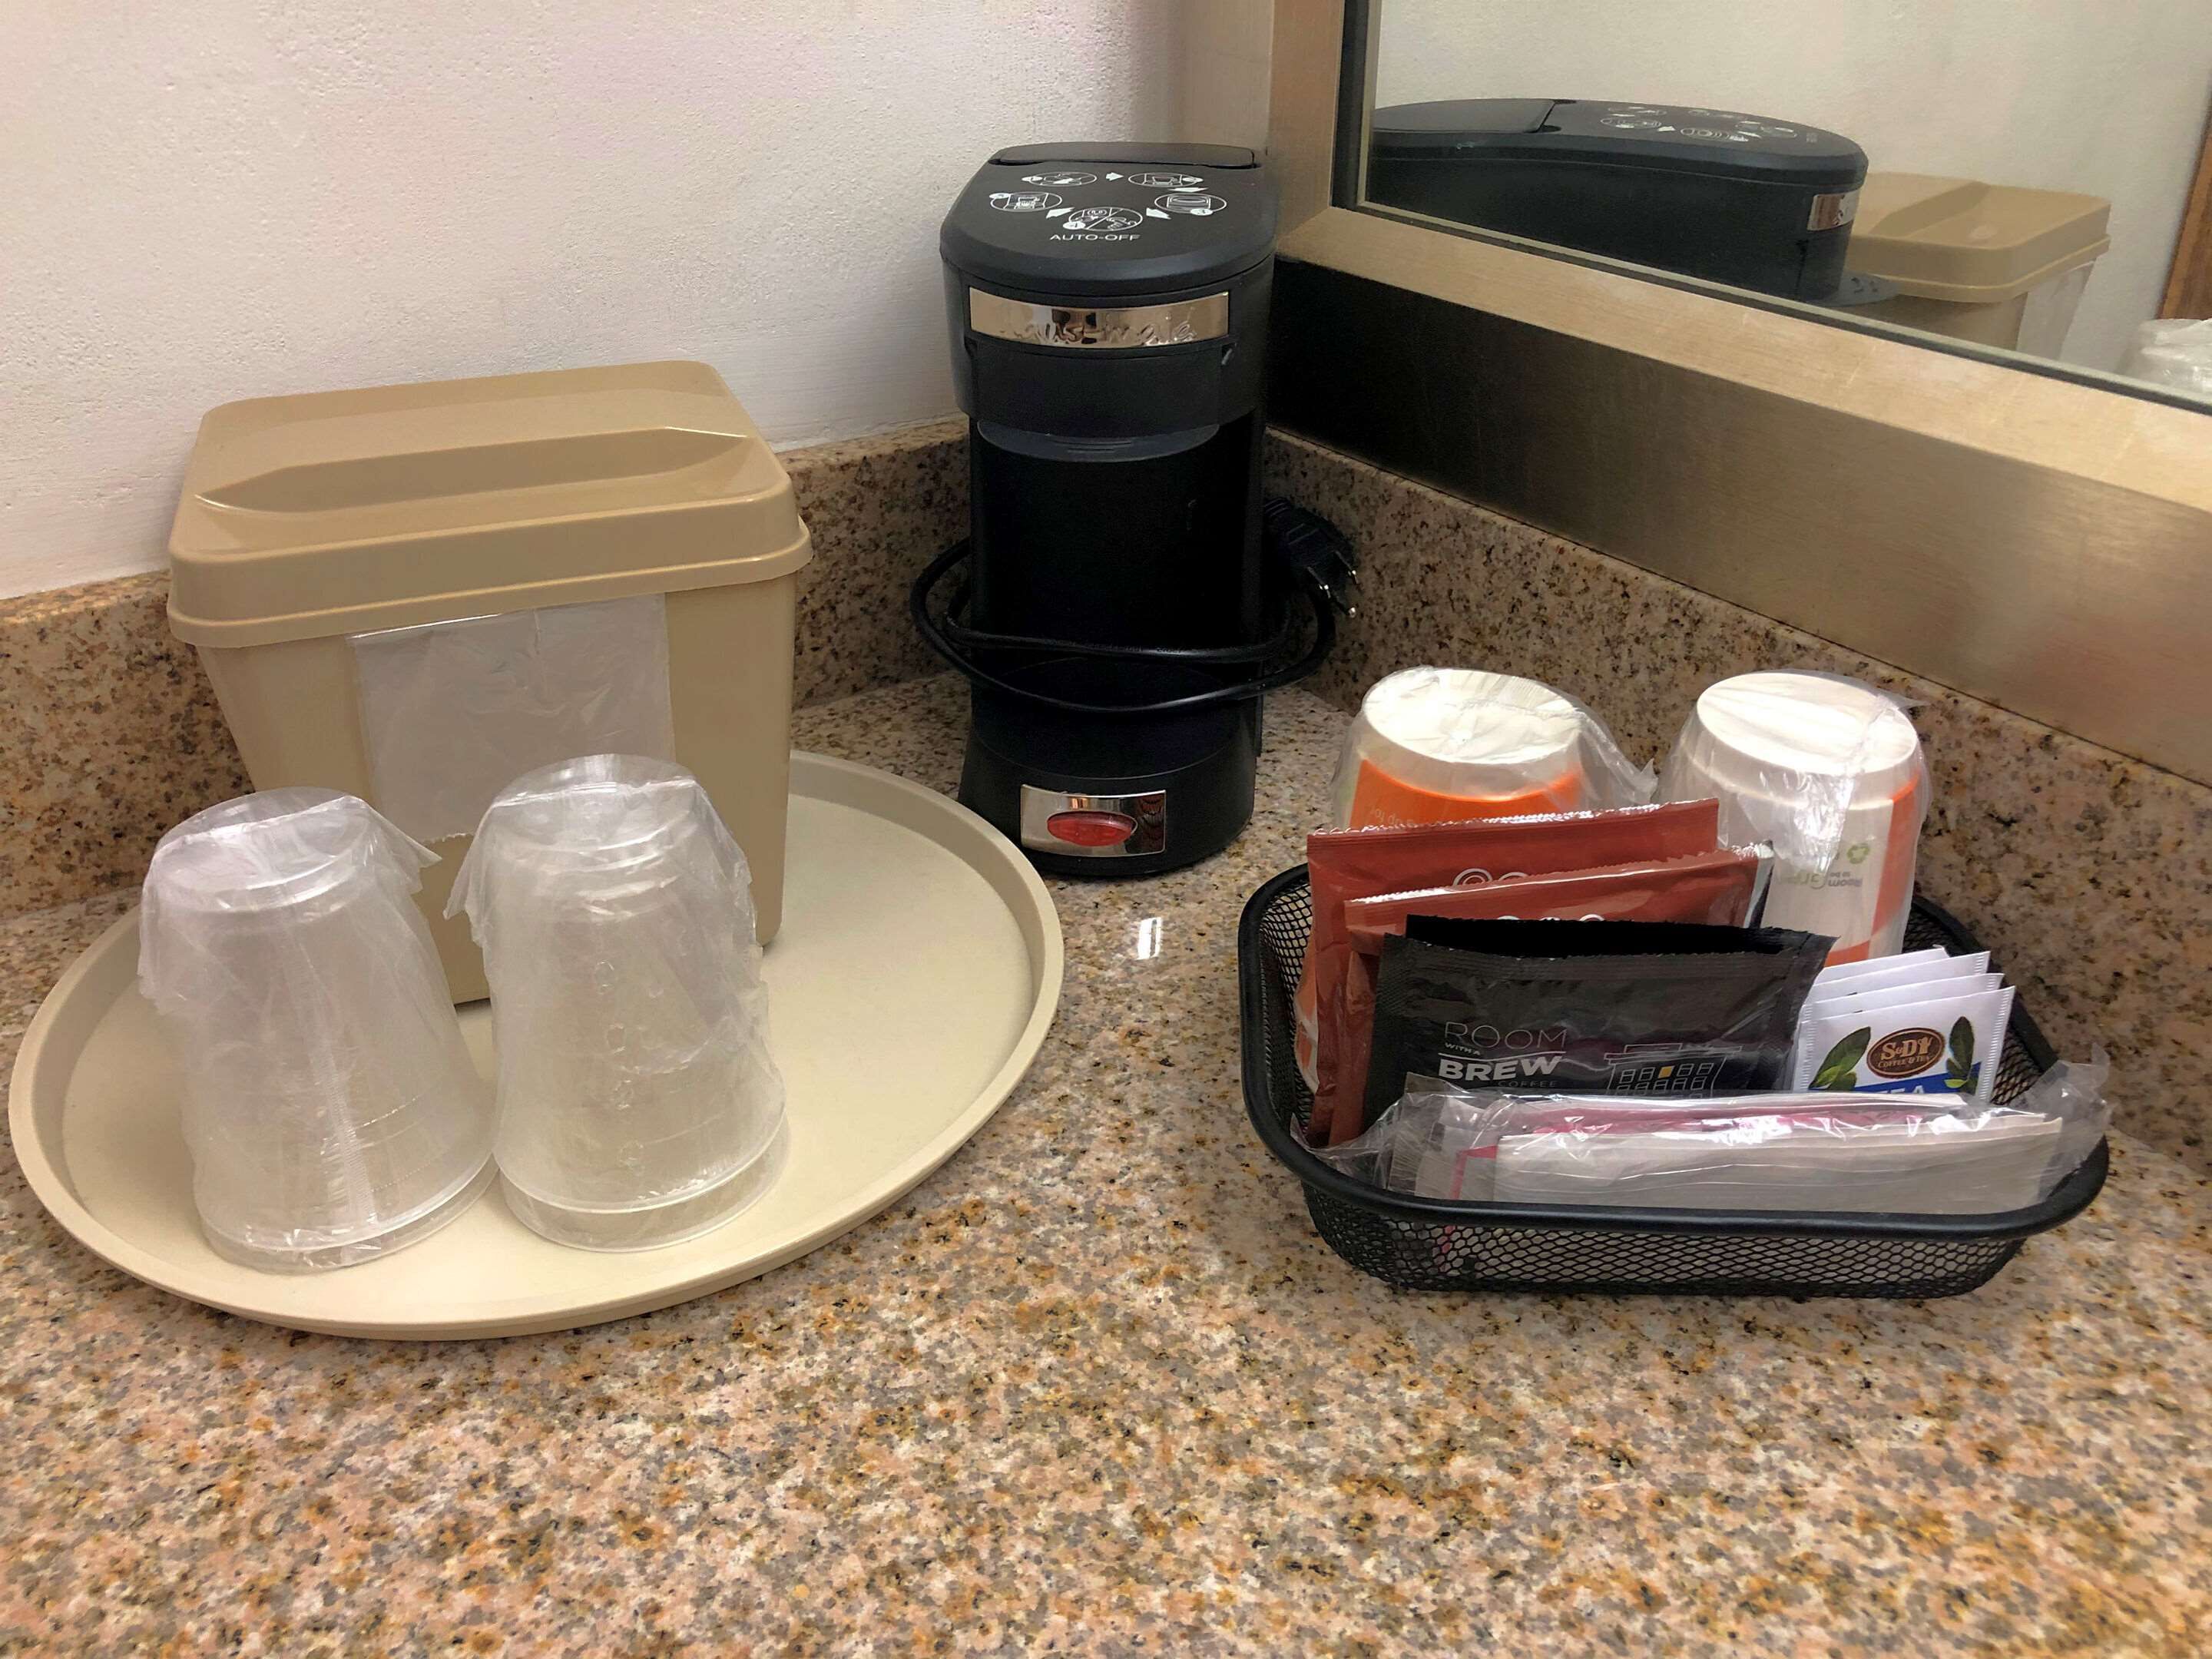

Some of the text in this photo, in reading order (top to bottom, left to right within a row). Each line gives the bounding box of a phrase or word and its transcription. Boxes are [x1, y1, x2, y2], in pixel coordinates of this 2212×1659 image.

[1444, 1021, 1568, 1050] ROOM
[1444, 1042, 1471, 1054] WITH
[1438, 1055, 1563, 1081] BREW
